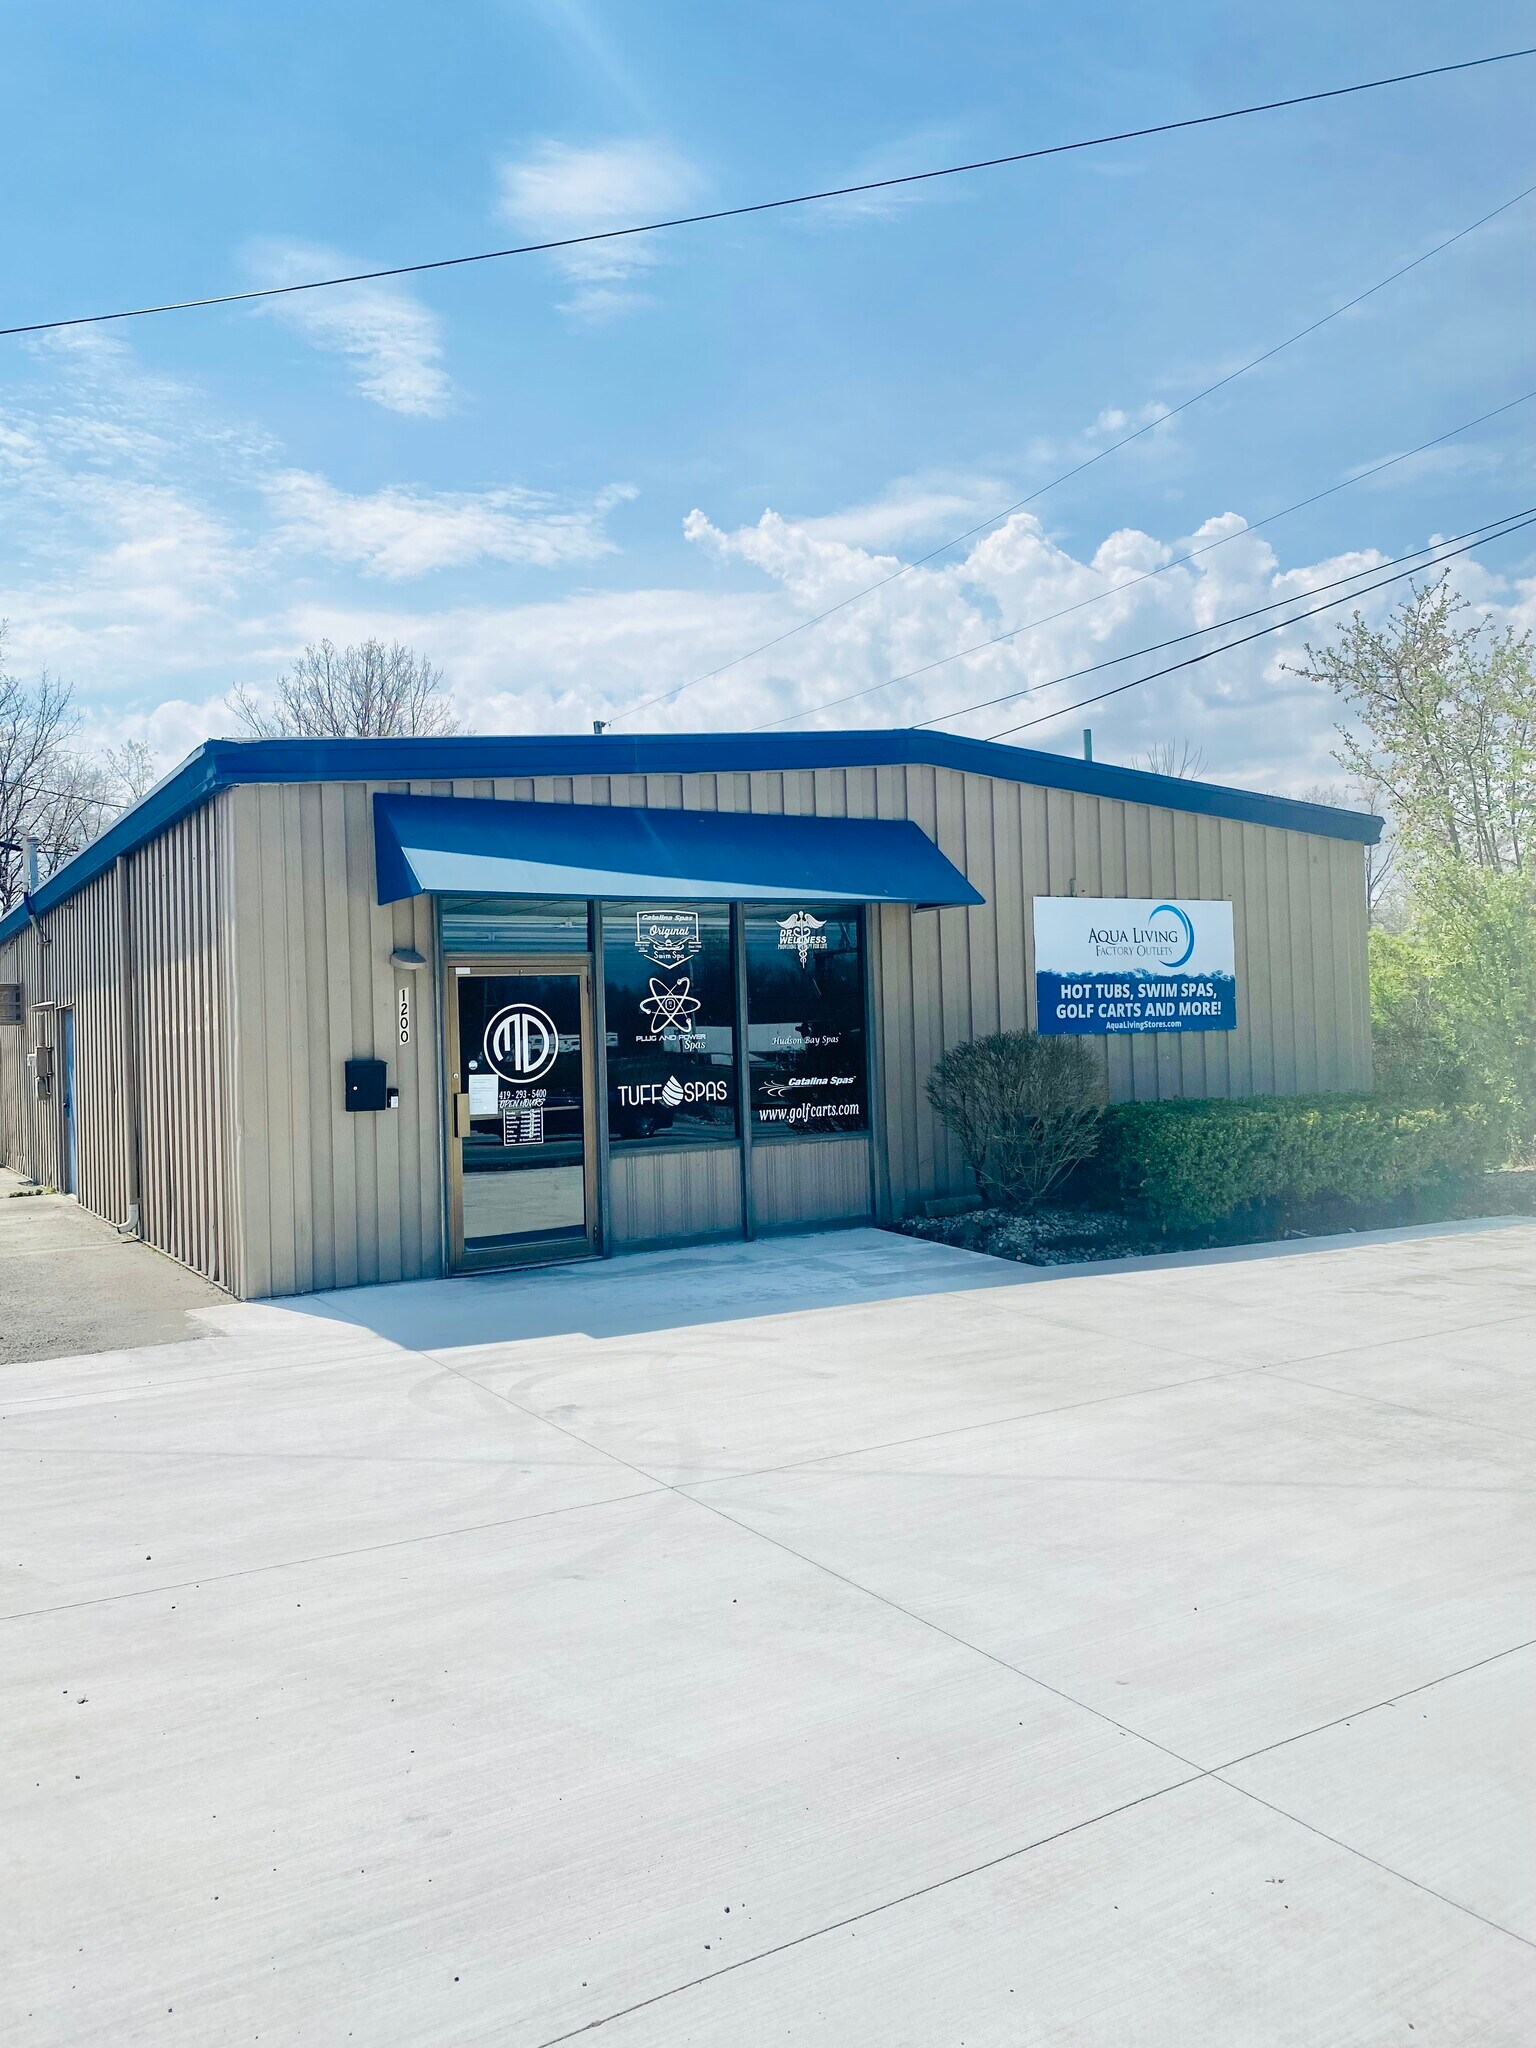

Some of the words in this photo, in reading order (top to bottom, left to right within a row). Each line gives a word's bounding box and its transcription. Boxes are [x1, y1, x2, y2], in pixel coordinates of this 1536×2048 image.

[650, 925, 690, 939] Original
[780, 929, 795, 937] DR.
[1088, 927, 1128, 946] AQUA
[1133, 927, 1178, 944] LIVING
[654, 951, 671, 959] Swim
[672, 951, 685, 961] Spa
[1096, 945, 1133, 957] FACTORY
[1137, 945, 1173, 957] OUTLETS
[1060, 984, 1093, 999] HOT
[1095, 984, 1134, 1001] TUBS,
[1138, 983, 1177, 998] SWIM
[1180, 983, 1218, 999] SPAS,
[400, 989, 409, 1043] 1200
[1056, 1003, 1094, 1019] GOLF
[1098, 1003, 1141, 1018] CARTS
[1145, 1002, 1176, 1017] AND
[1179, 1001, 1222, 1016] MORE!
[1106, 1021, 1182, 1031] AquaLivingStores.com
[684, 1040, 706, 1052] Spas
[771, 1036, 802, 1045] Hudson
[805, 1036, 820, 1046] Bay
[822, 1035, 839, 1046] Spas
[788, 1077, 828, 1086] Catalina
[830, 1076, 854, 1086] Spas
[617, 1084, 663, 1106] TUFF
[684, 1080, 727, 1103] SPAS
[499, 1099, 520, 1108] OPEN
[759, 1102, 860, 1123] www.golfcarts.com
